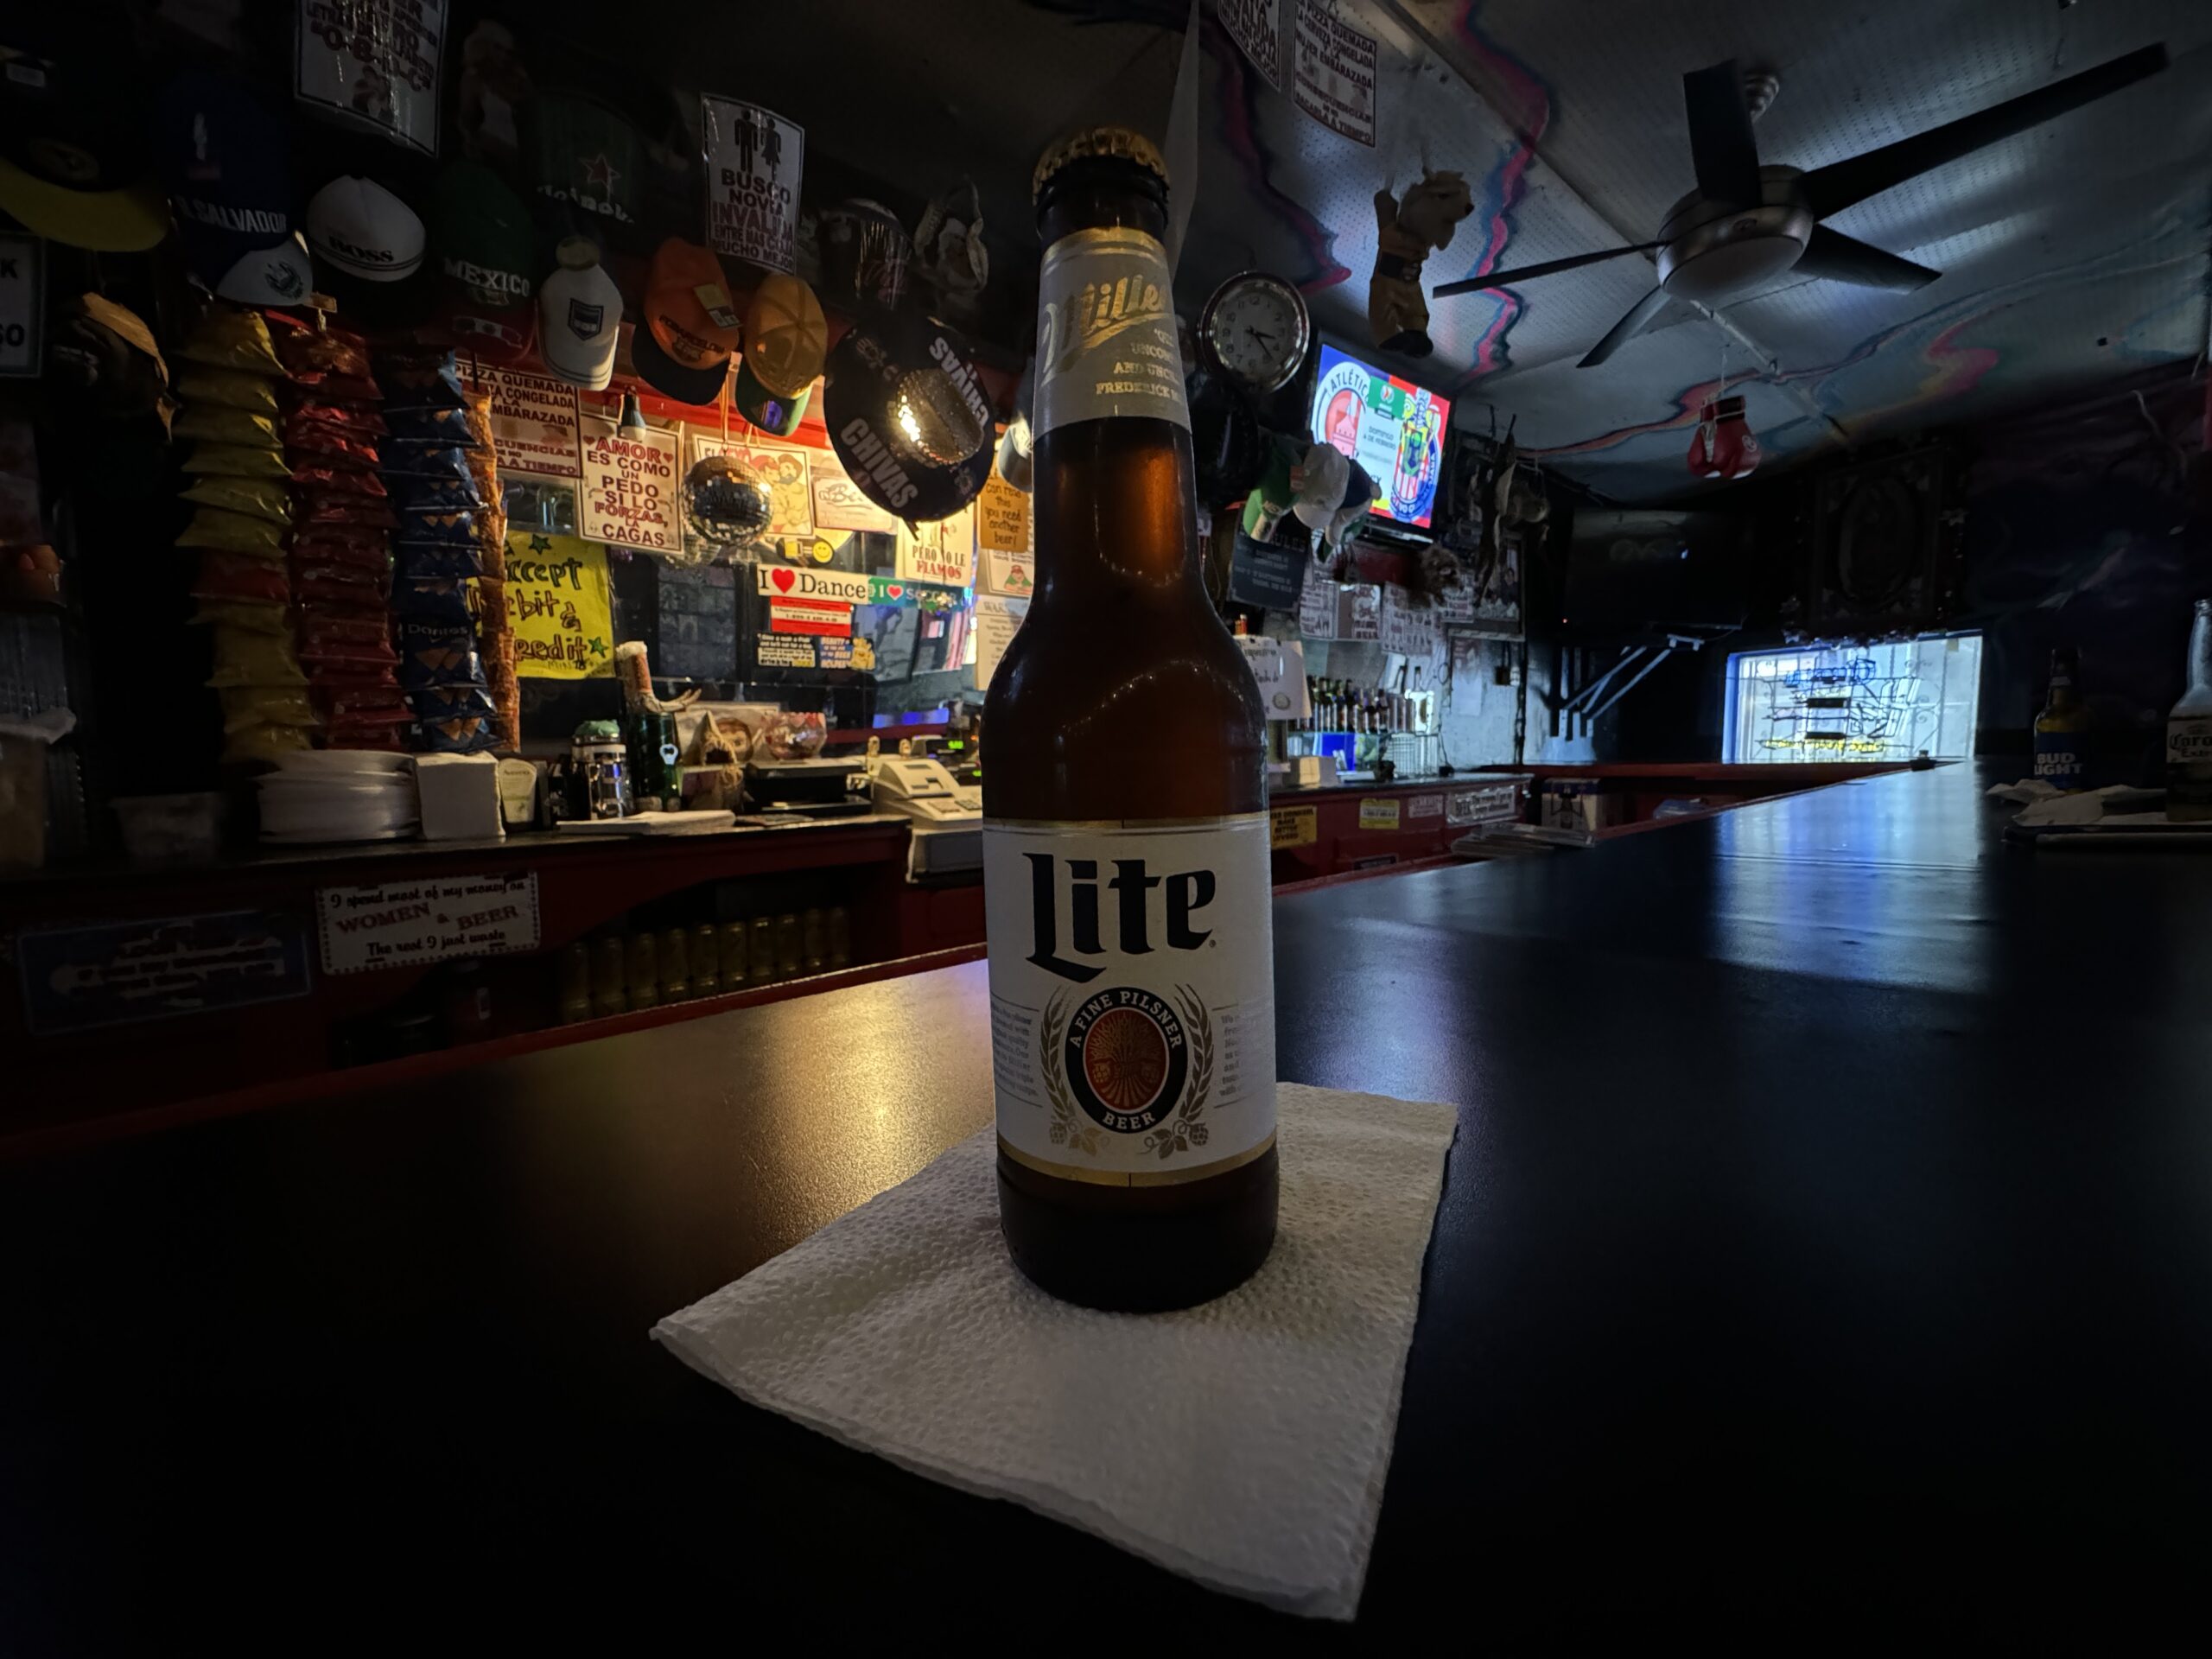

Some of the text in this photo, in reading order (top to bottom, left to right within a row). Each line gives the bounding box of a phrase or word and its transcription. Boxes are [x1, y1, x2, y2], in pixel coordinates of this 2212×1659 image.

[1331, 24, 1373, 52] QUEMADA
[1319, 52, 1372, 90] EMBARAZADA
[721, 168, 791, 205] BUSCO
[328, 235, 395, 263] BOSS
[444, 257, 531, 298] MEXICO
[501, 373, 575, 396] QUEMADA
[929, 336, 990, 429] CHIVAS
[1331, 368, 1369, 399] ATLÉTIC
[502, 397, 521, 408] LA
[505, 386, 575, 410] CONGELADA
[491, 404, 576, 428] MBARAZADA
[494, 439, 576, 458] CUENCIAS
[595, 435, 662, 464] AMOR
[523, 459, 576, 474] TIEMPO
[587, 449, 671, 478] ES COMO
[620, 468, 639, 481] UN
[839, 417, 919, 509] CHIVAS
[601, 474, 659, 498] PEDO
[605, 490, 658, 512] SI LO
[602, 523, 665, 547] CAGAS
[625, 517, 640, 528] LA
[912, 544, 938, 563] PERO
[505, 556, 582, 591] ccept
[916, 559, 962, 580] FIAMOS
[759, 569, 867, 600] I Dance
[513, 633, 588, 664] redit
[2033, 762, 2084, 777] LIGHT
[2036, 752, 2076, 765] BUD
[387, 887, 420, 903] most
[423, 884, 439, 900] of
[442, 886, 463, 899] my
[465, 881, 507, 896] money
[510, 880, 525, 892] on
[336, 902, 431, 935] WOMEN
[456, 905, 519, 931] BEER
[1022, 853, 1216, 983] Lite
[366, 941, 393, 956] The
[396, 938, 423, 953] rest
[441, 932, 467, 950] just
[469, 929, 506, 944] waste
[1070, 990, 1183, 1050] A FINE PILSNER
[1102, 1111, 1156, 1131] BEER
